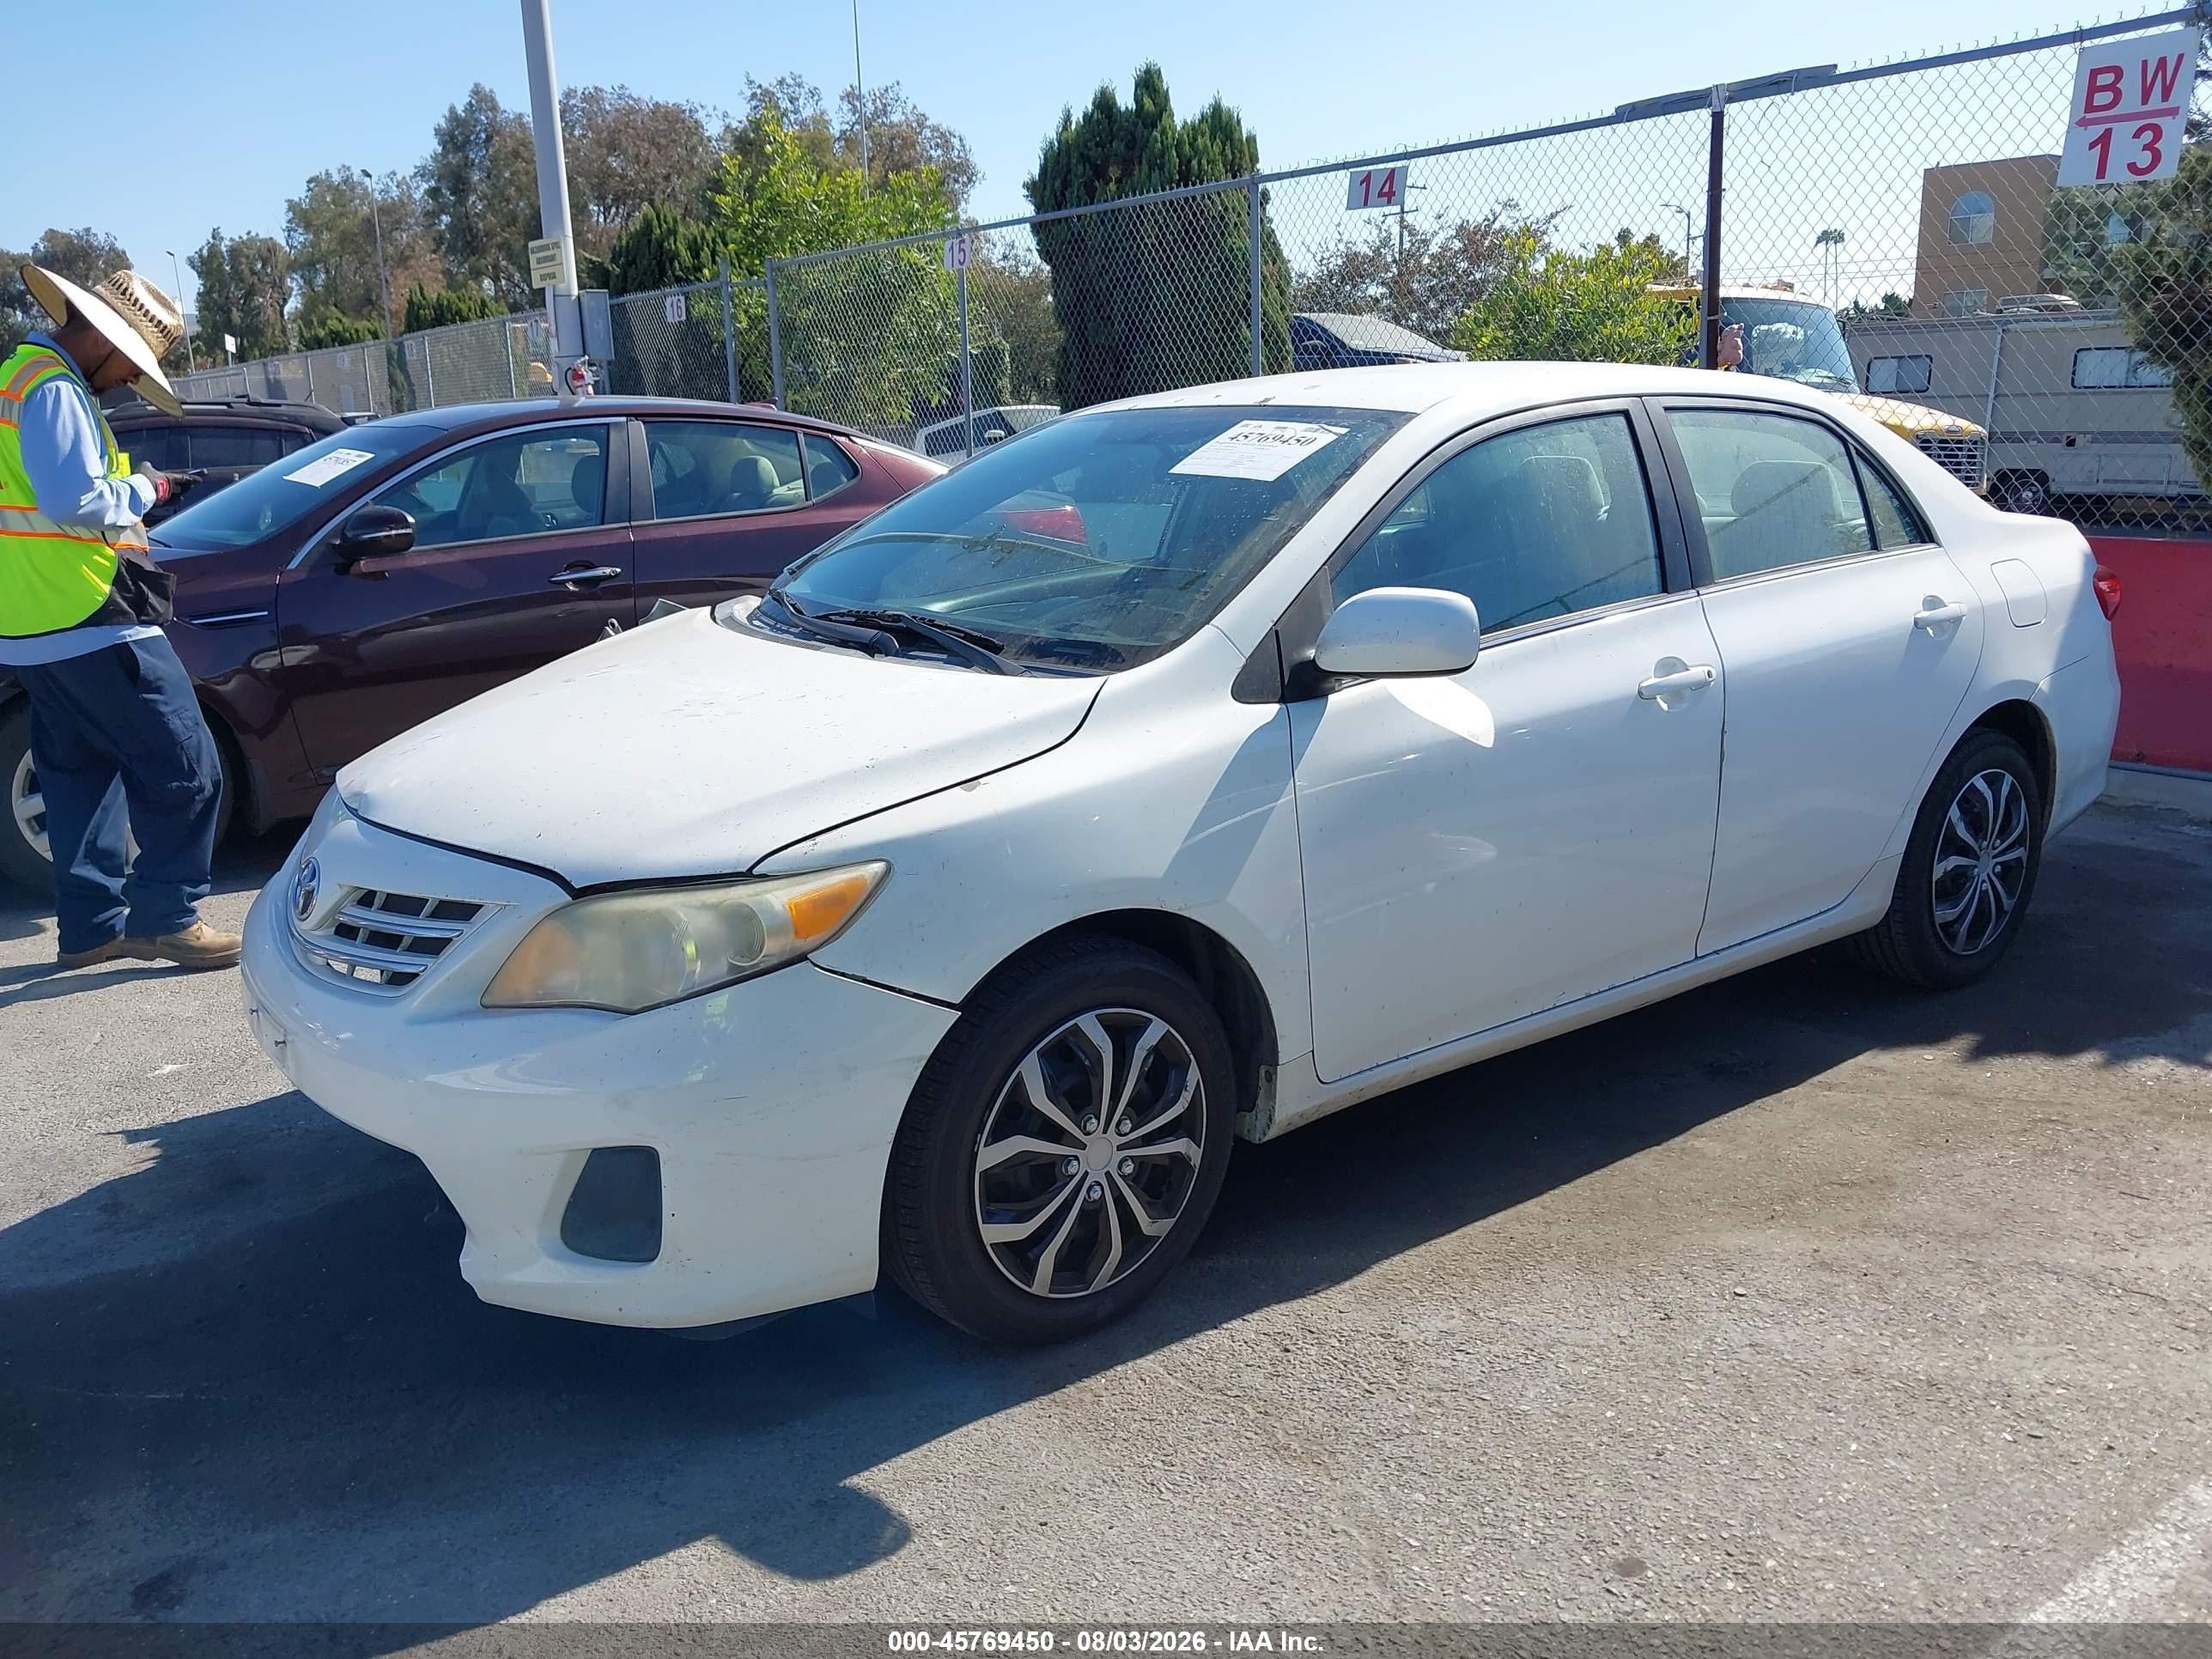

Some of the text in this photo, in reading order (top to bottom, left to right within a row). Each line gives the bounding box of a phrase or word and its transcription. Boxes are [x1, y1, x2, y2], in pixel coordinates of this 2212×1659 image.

[2087, 122, 2164, 180] 13
[1359, 167, 1396, 207] 14
[948, 239, 967, 268] 15
[670, 298, 683, 321] 16
[1228, 431, 1317, 447] 45769450
